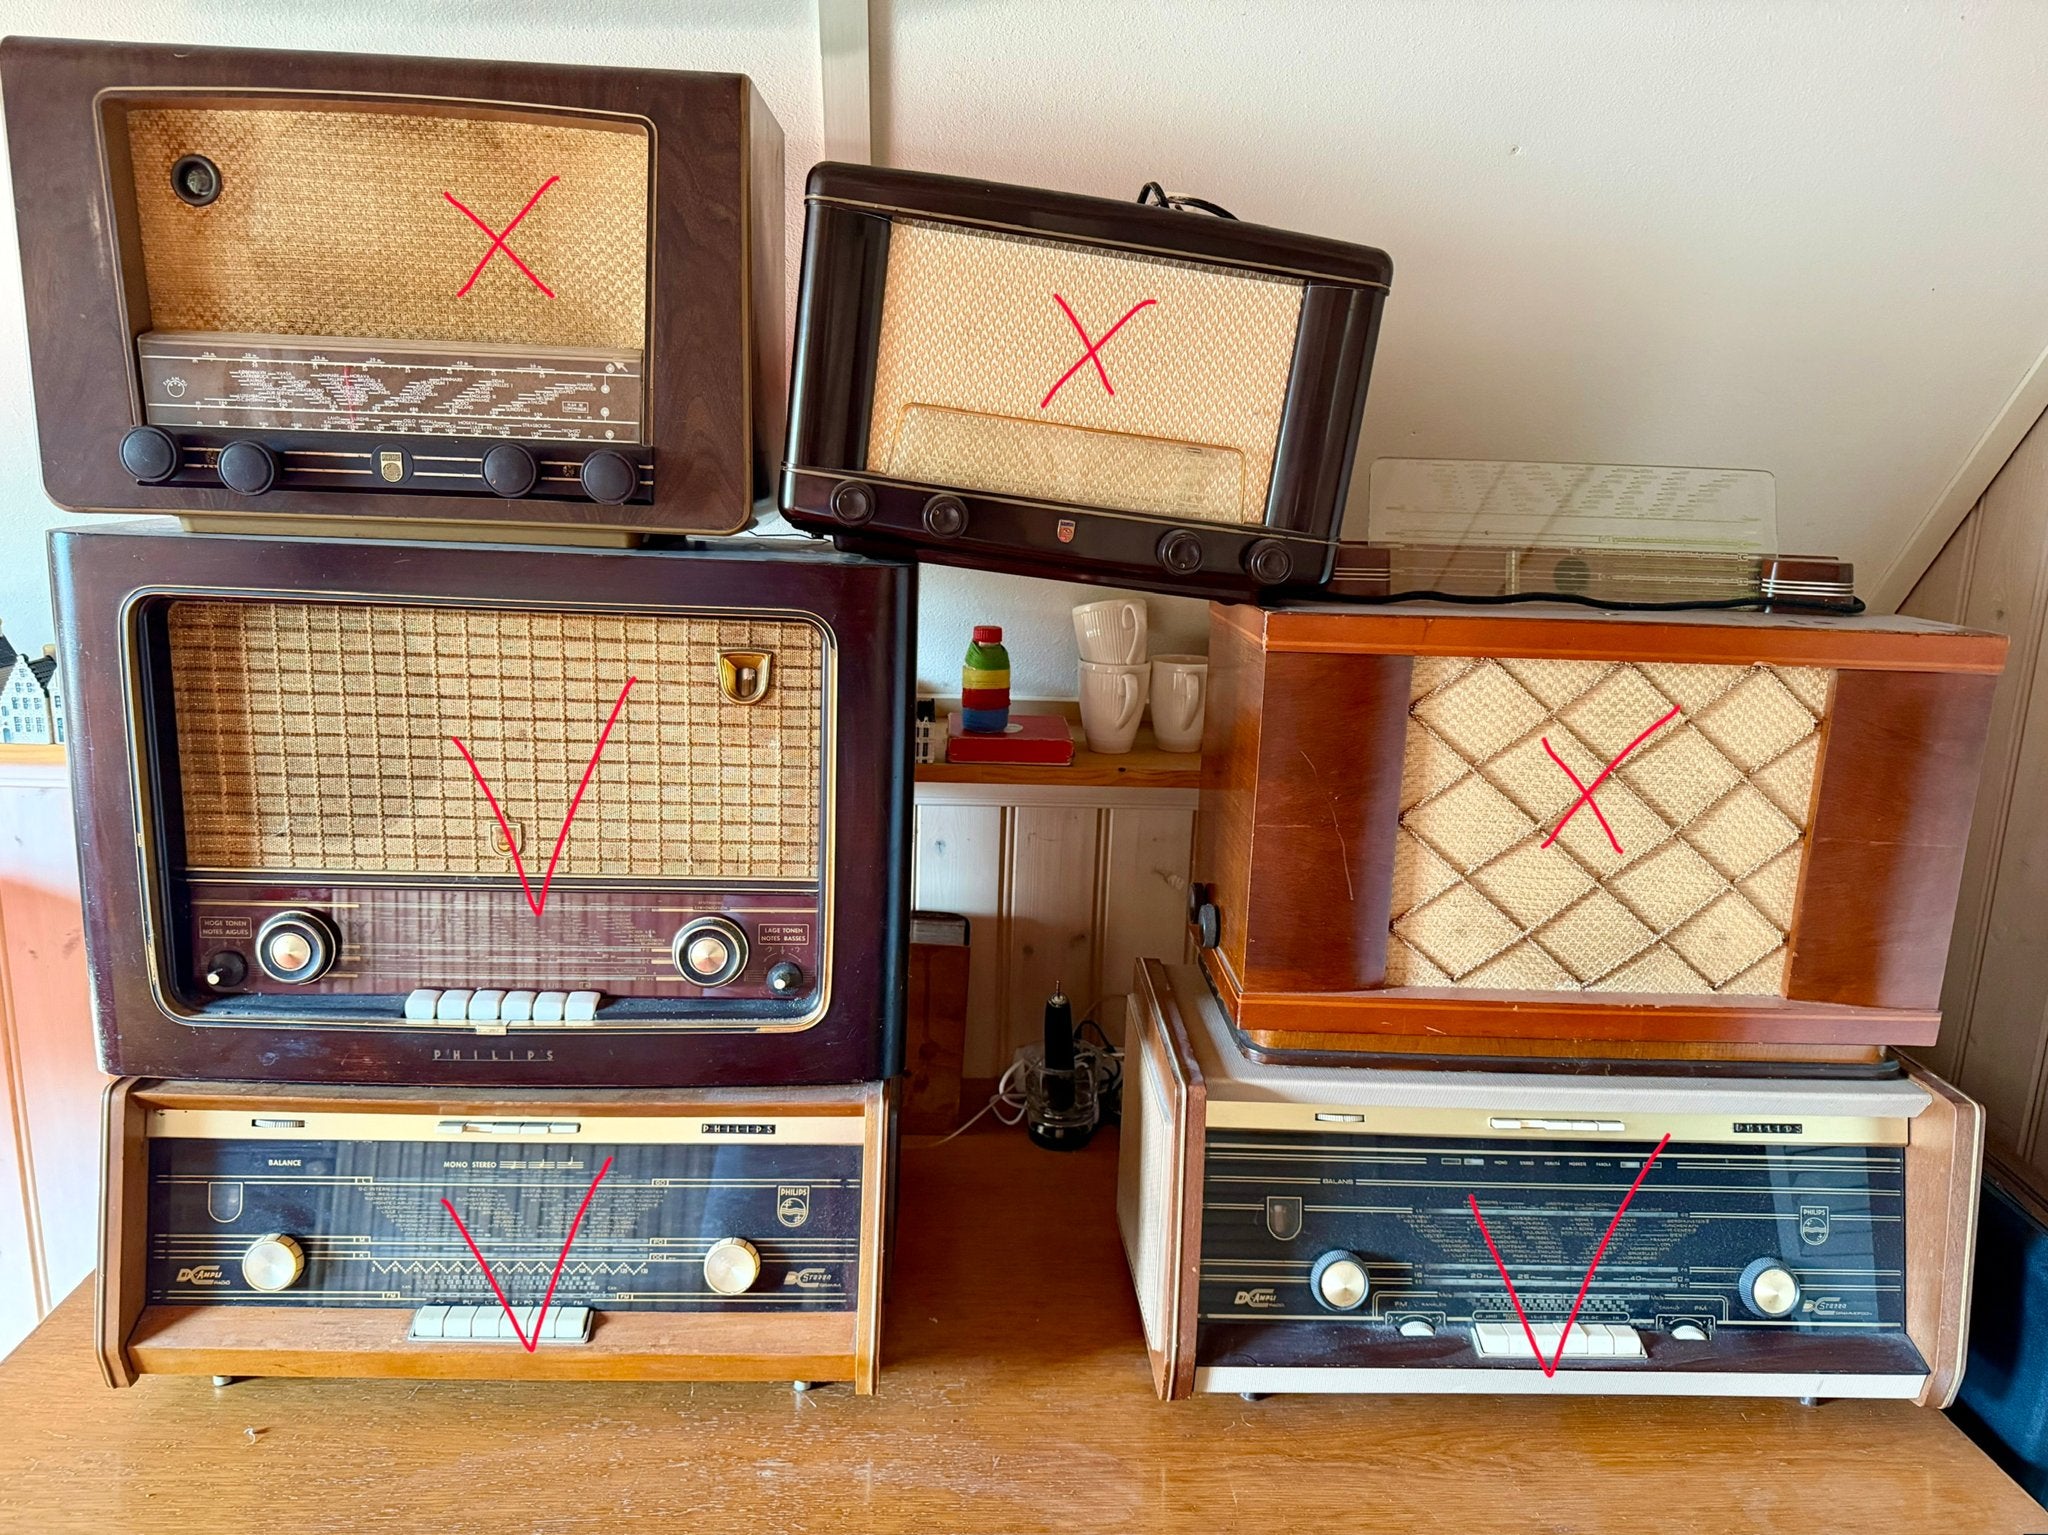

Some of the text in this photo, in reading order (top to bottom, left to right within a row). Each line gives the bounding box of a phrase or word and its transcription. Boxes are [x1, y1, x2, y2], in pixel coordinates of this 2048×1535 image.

[434, 1050, 554, 1060] PHILIPS
[703, 1124, 775, 1134] PHILIPS
[1735, 1124, 1802, 1134] PHILIPS
[268, 1159, 302, 1167] BALANCE
[780, 1188, 807, 1197] PHILIPS
